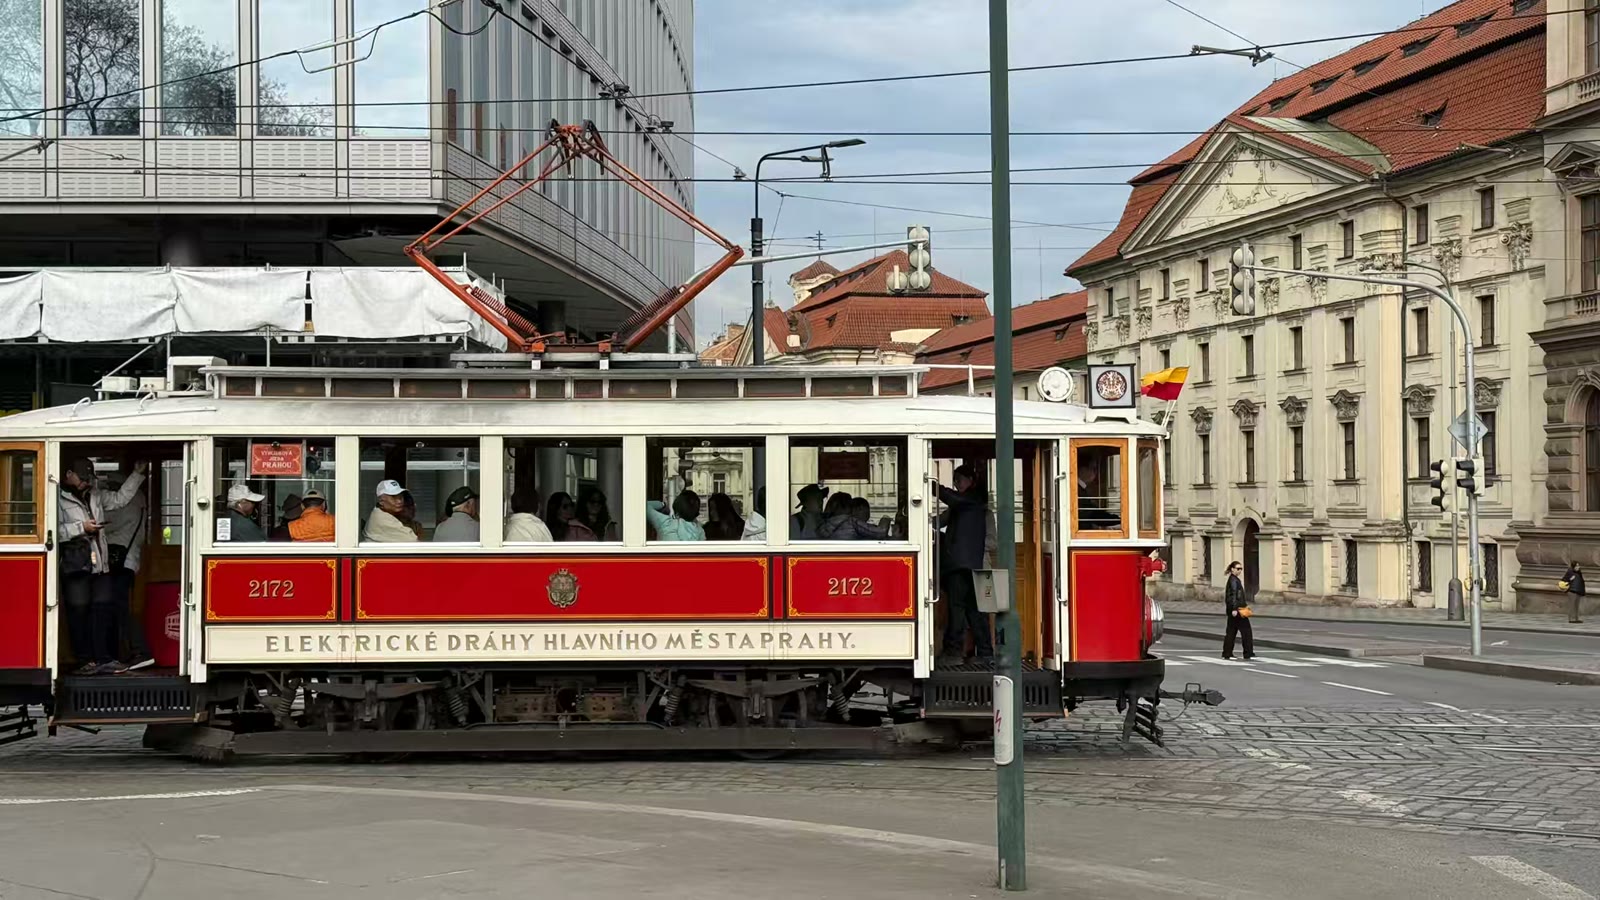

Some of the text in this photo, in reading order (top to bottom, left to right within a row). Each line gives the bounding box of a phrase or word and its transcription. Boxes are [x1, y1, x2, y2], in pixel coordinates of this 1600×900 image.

[262, 461, 292, 469] PRAHOU
[248, 579, 295, 598] 2172
[828, 577, 873, 595] 2172
[265, 632, 438, 653] ELEKTRICKÉ
[447, 631, 535, 651] DRÁHY
[543, 629, 658, 650] HLAVNÍHO
